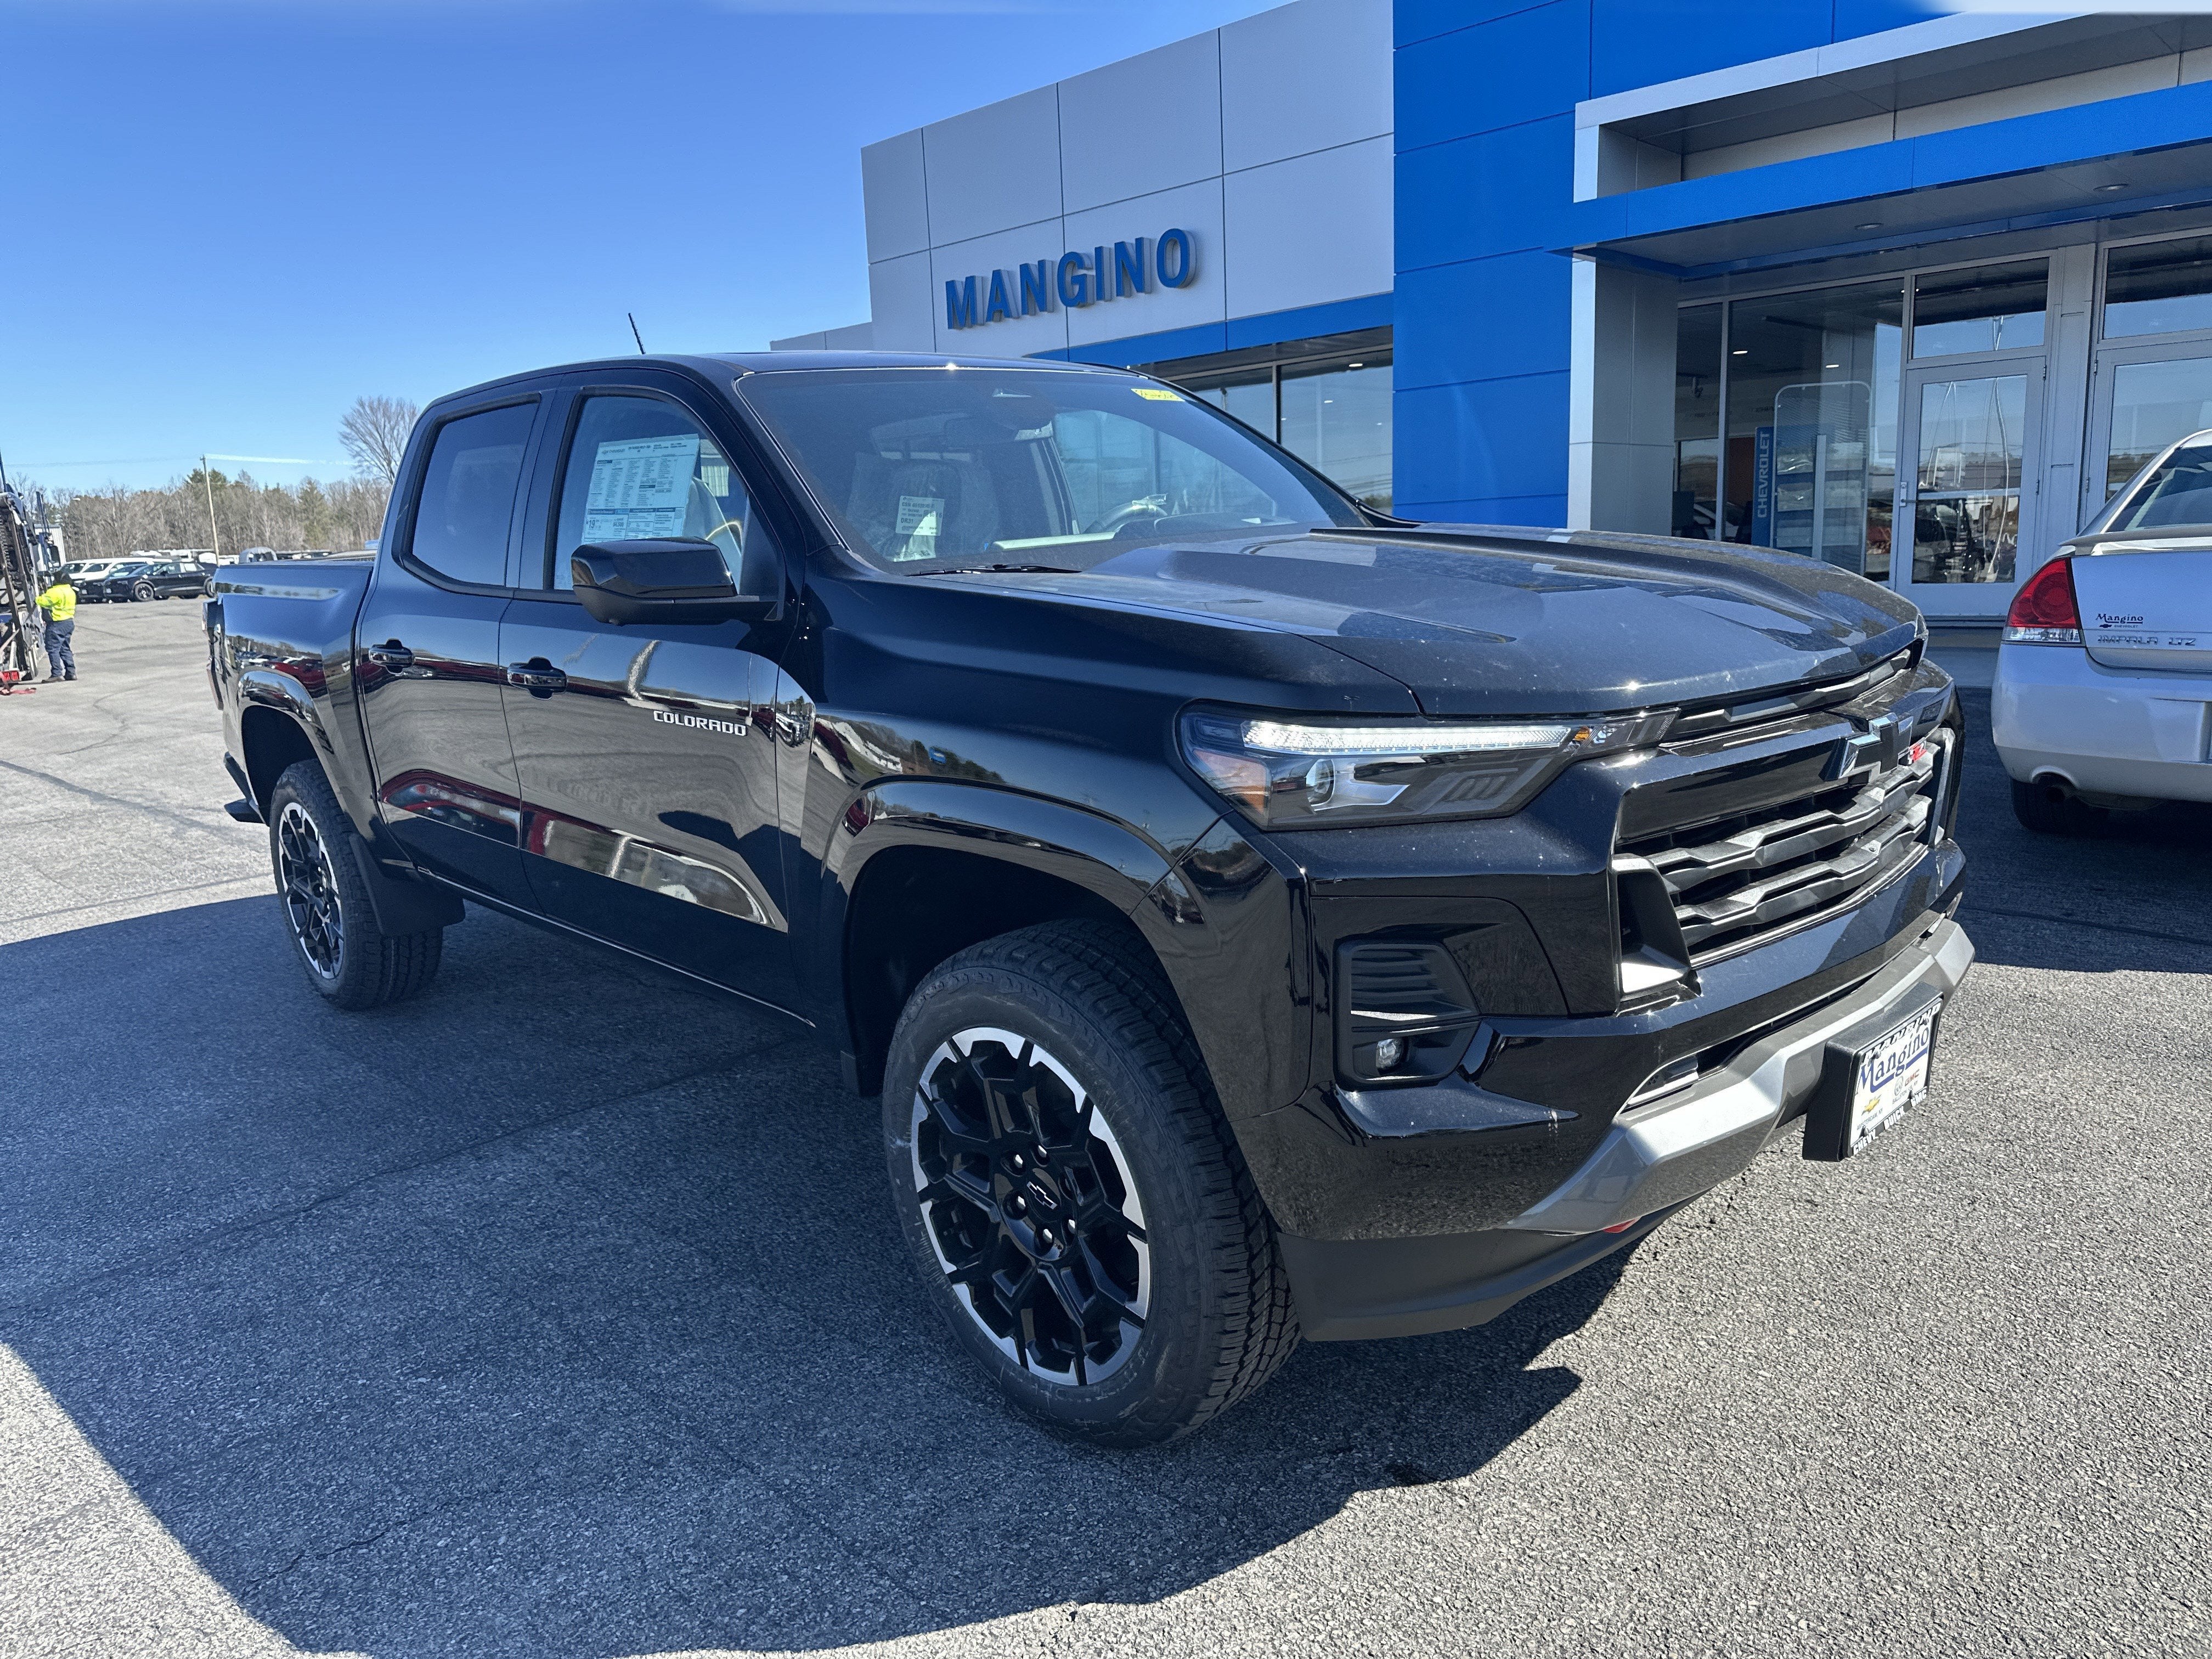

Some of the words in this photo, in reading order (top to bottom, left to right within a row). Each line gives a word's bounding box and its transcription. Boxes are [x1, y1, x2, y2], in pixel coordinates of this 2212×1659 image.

[945, 228, 1196, 330] MANGINO
[1757, 431, 1770, 518] CHEVROLET
[2096, 613, 2144, 624] Mangino
[2097, 635, 2158, 645] IMPALA
[2169, 637, 2197, 646] LTZ
[653, 710, 746, 736] COLORADO
[1855, 1027, 1929, 1093] Mangino
[1905, 1069, 1920, 1087] GMC
[1910, 1089, 1927, 1107] GMC
[1884, 1106, 1906, 1130] BUICK
[1853, 1128, 1876, 1155] CHEVY
